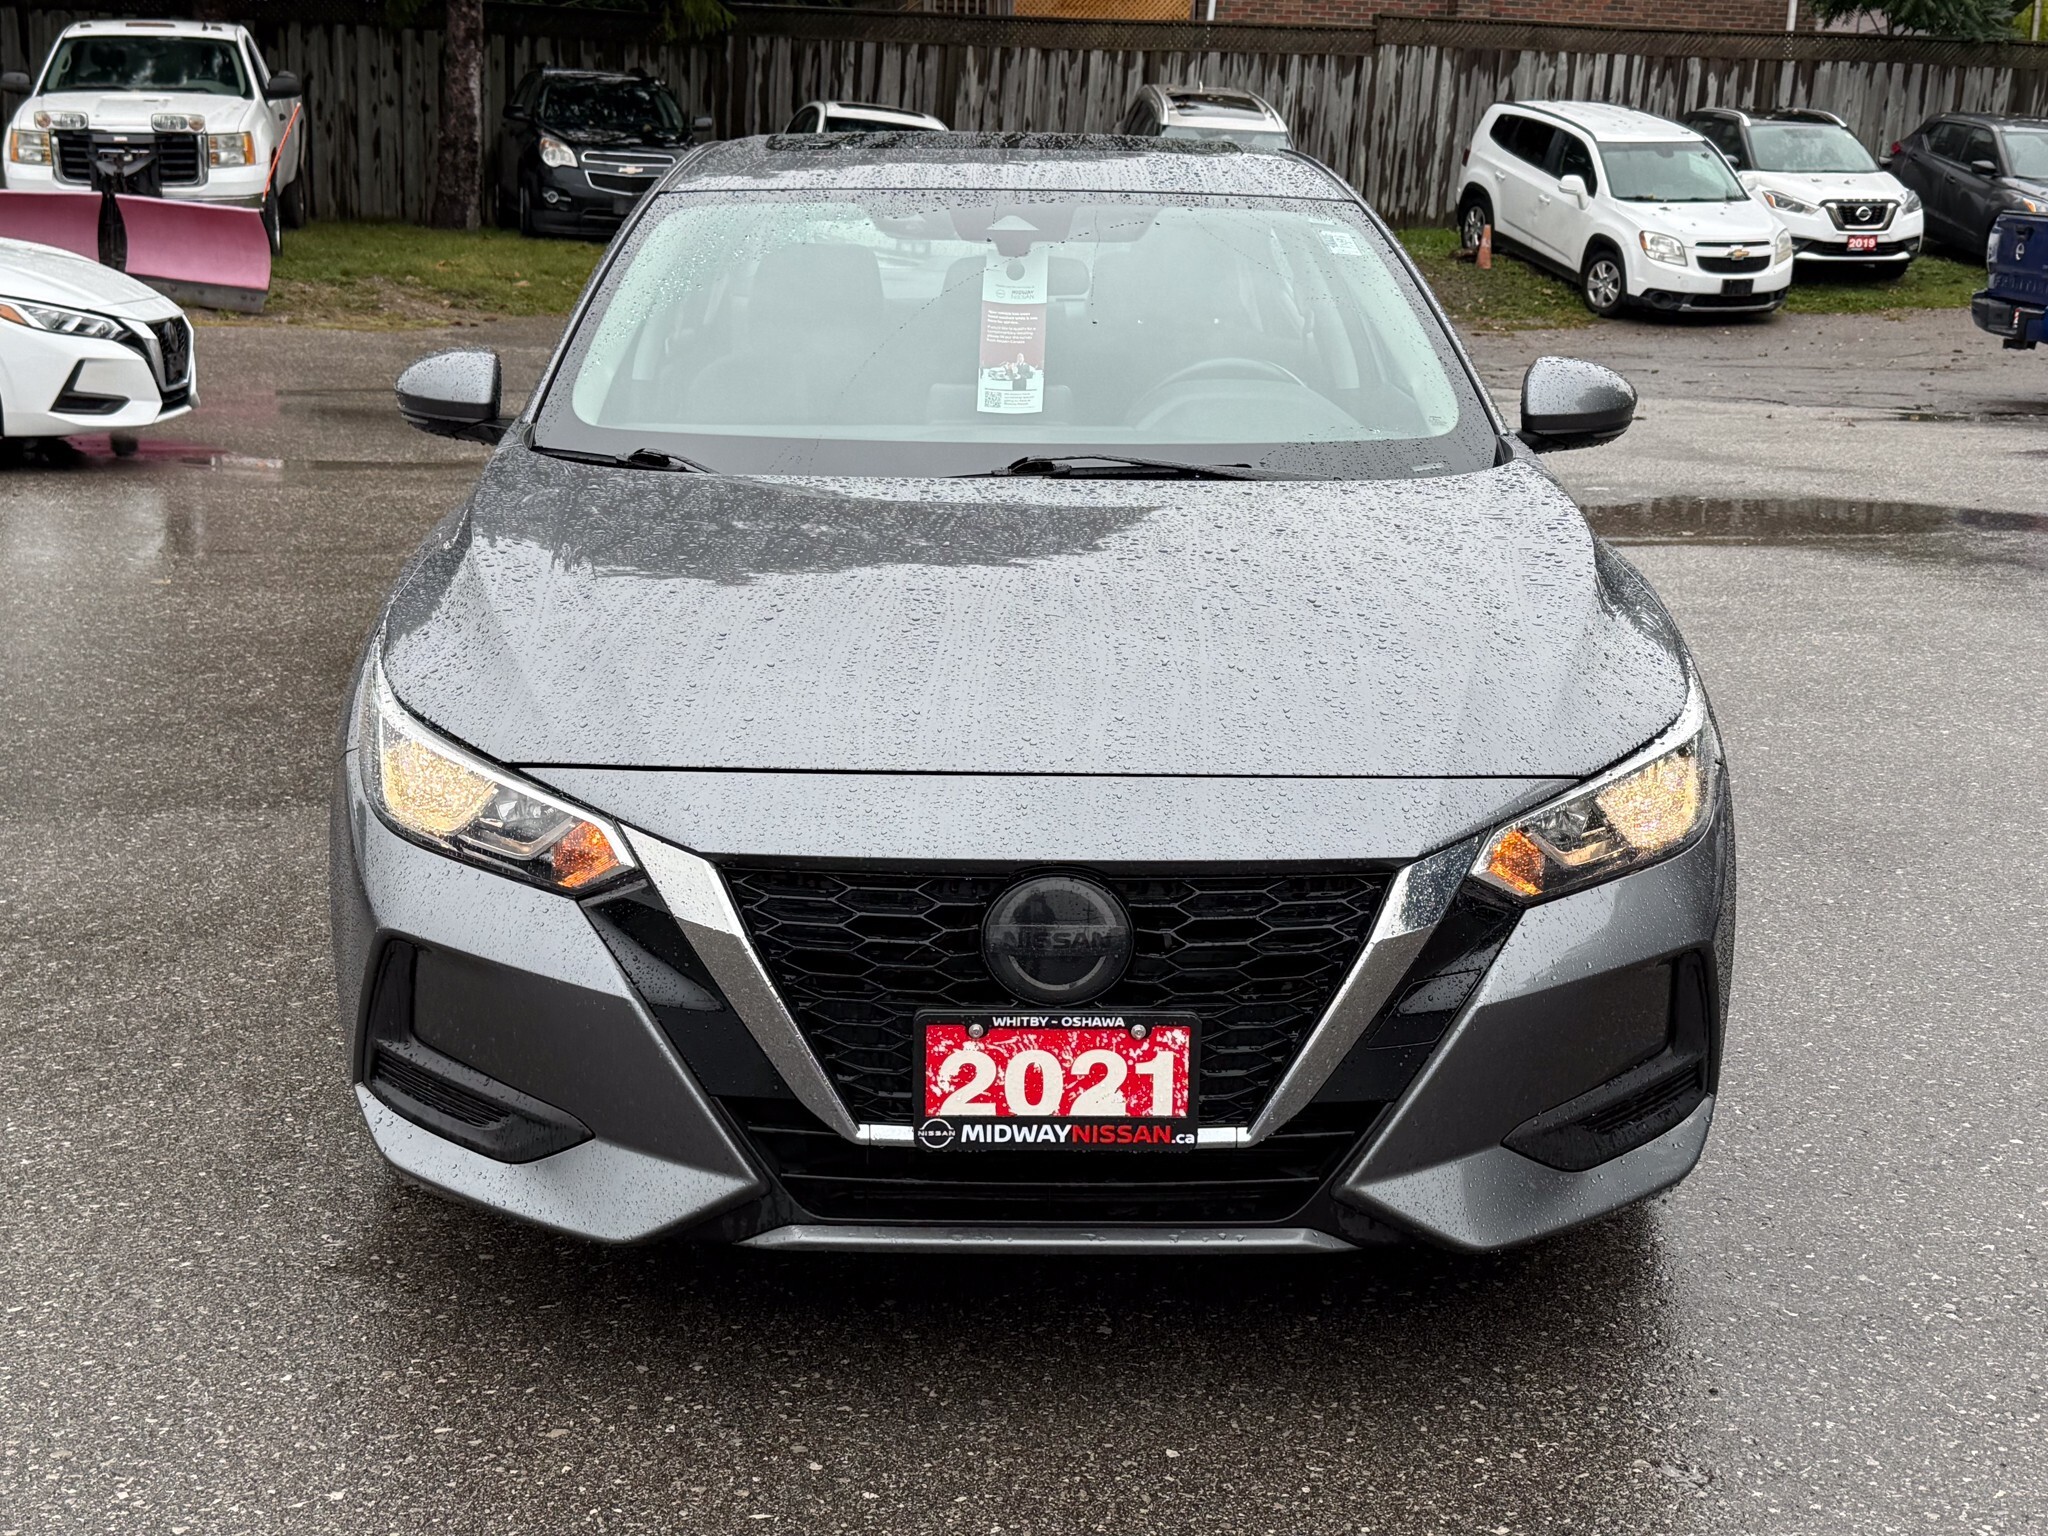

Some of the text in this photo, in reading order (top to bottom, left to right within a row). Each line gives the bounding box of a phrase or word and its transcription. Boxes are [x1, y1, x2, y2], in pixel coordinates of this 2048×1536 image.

[1849, 238, 1876, 248] 2019
[1002, 931, 1112, 949] NISSAN
[992, 1016, 1049, 1027] WHITBY
[1061, 1016, 1126, 1027] OSHAWA
[938, 1049, 1176, 1116] 2021
